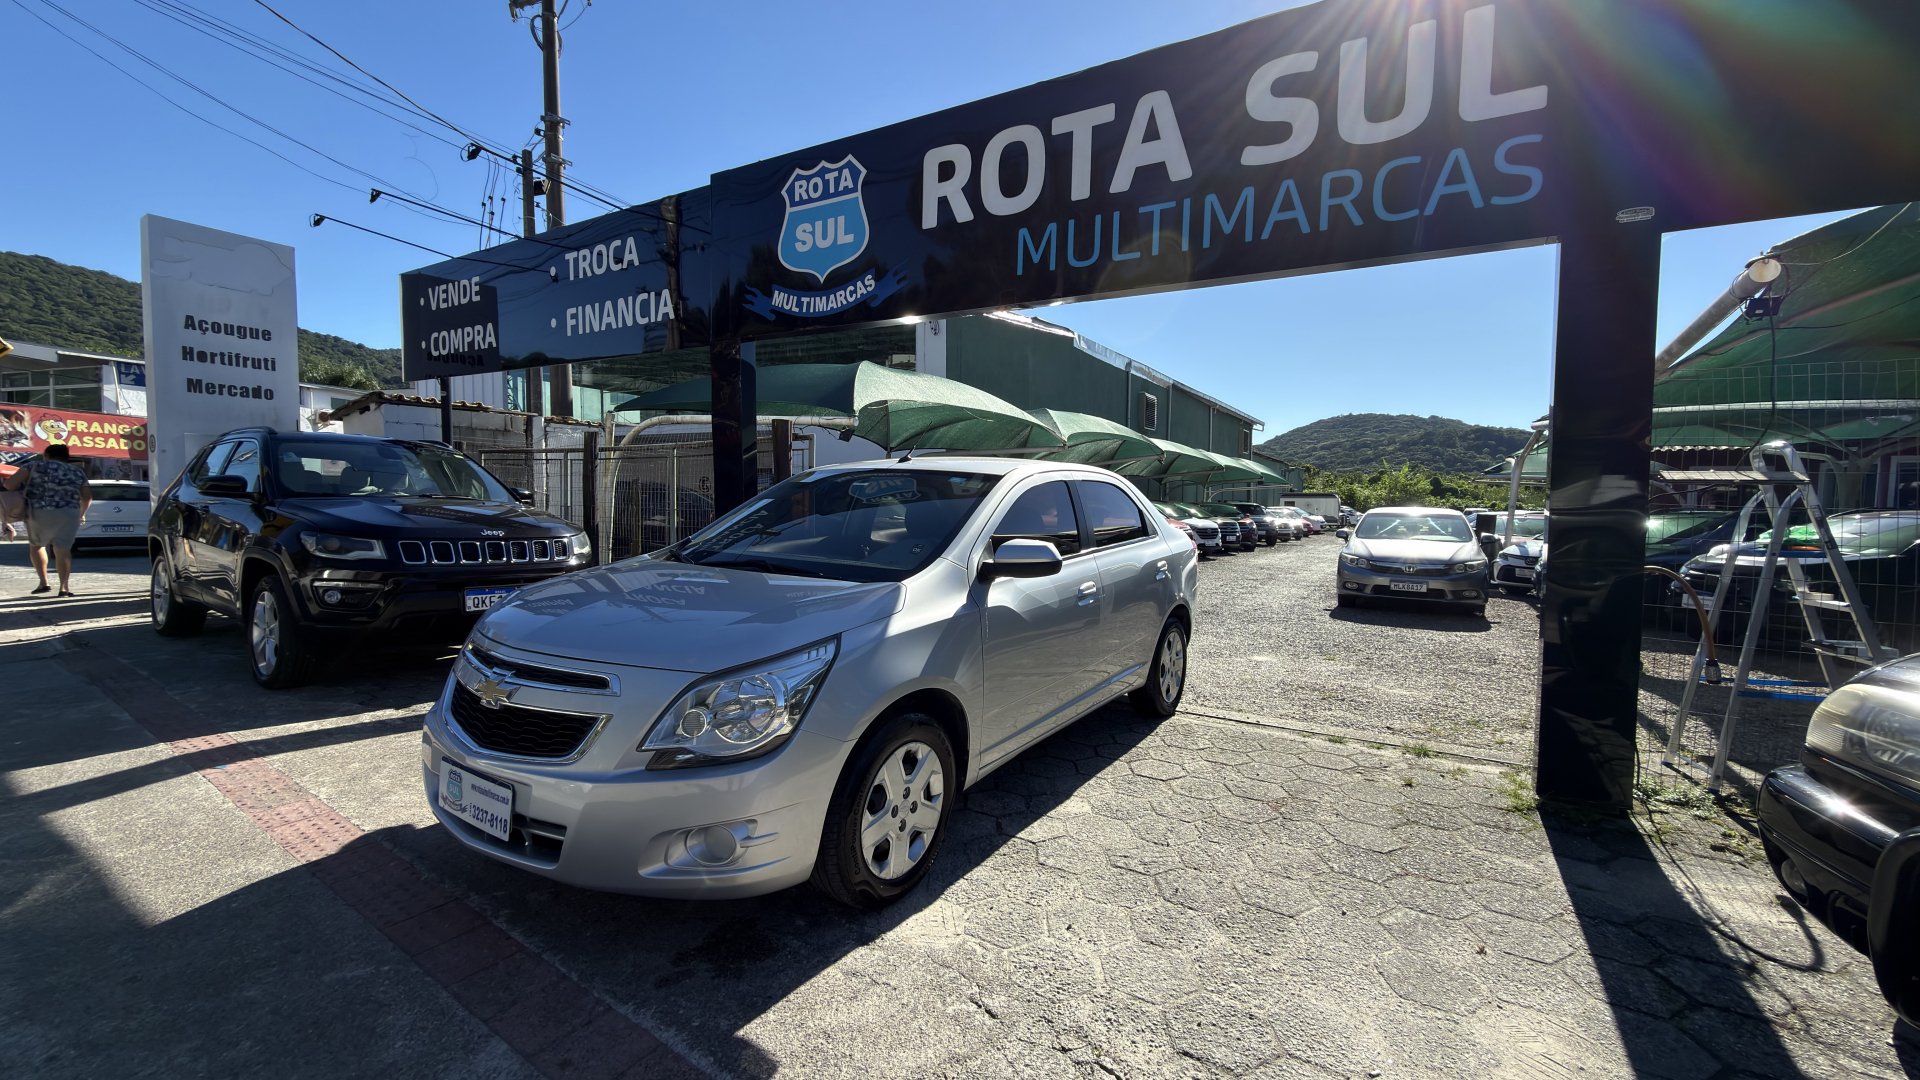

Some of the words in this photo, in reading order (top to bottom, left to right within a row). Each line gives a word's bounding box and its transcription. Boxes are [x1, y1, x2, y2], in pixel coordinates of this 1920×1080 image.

[921, 89, 1193, 230] ROTA
[1240, 4, 1549, 166] SUL
[794, 168, 854, 201] ROTA
[1016, 134, 1544, 276] MULTIMARCAS
[795, 215, 854, 252] SUL
[565, 236, 640, 280] TROCA
[428, 276, 481, 311] VENDE
[772, 274, 876, 313] MULTIMARCAS
[184, 314, 272, 341] Açougue
[566, 288, 675, 337] FINANCIA
[430, 322, 497, 356] COMPRA
[182, 345, 276, 371] Hortifruti
[186, 377, 274, 400] Mercado
[66, 419, 145, 437] FRANGO
[67, 434, 146, 451] ASSADO
[480, 529, 505, 537] Jeep
[472, 805, 508, 834] 3237-8118
